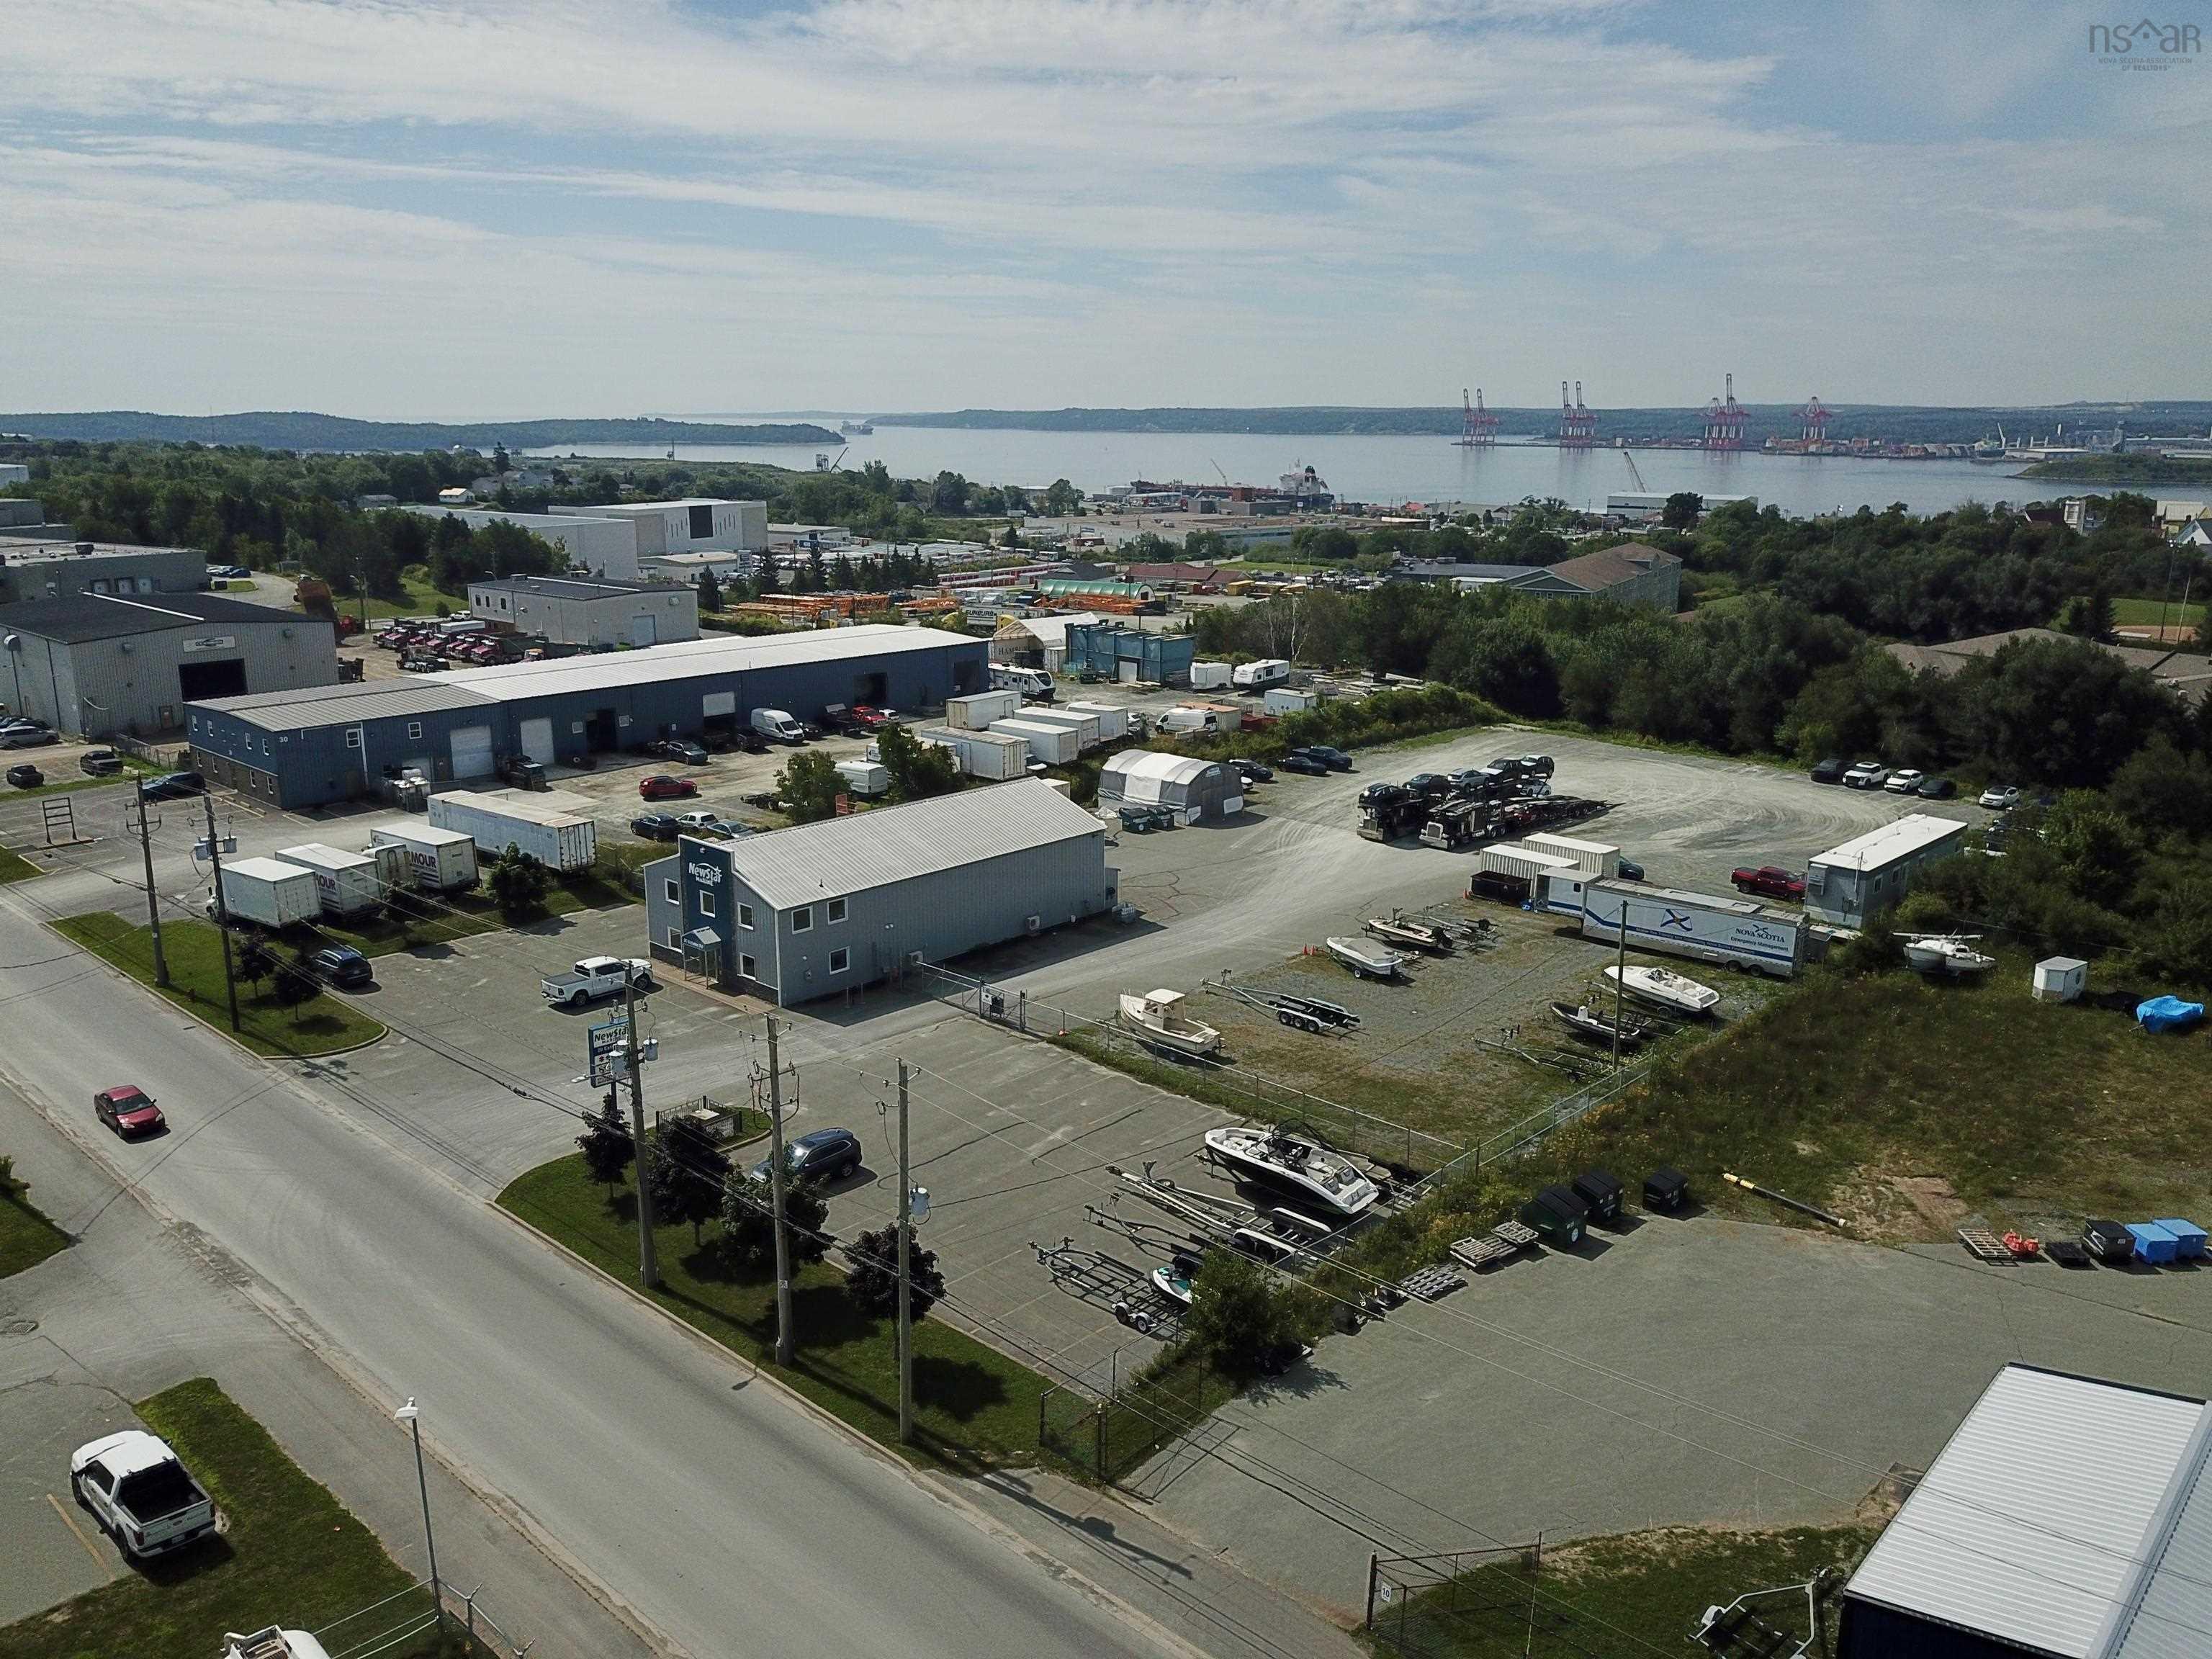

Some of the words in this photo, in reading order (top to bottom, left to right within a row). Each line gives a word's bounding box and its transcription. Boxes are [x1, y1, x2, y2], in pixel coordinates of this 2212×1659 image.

[688, 862, 721, 883] NewStar
[1735, 927, 1755, 938] NOVA
[1756, 932, 1785, 943] SCOTIA
[1730, 936, 1757, 946] Emergency
[1757, 941, 1789, 951] Management
[1382, 1587, 1390, 1598] 10
